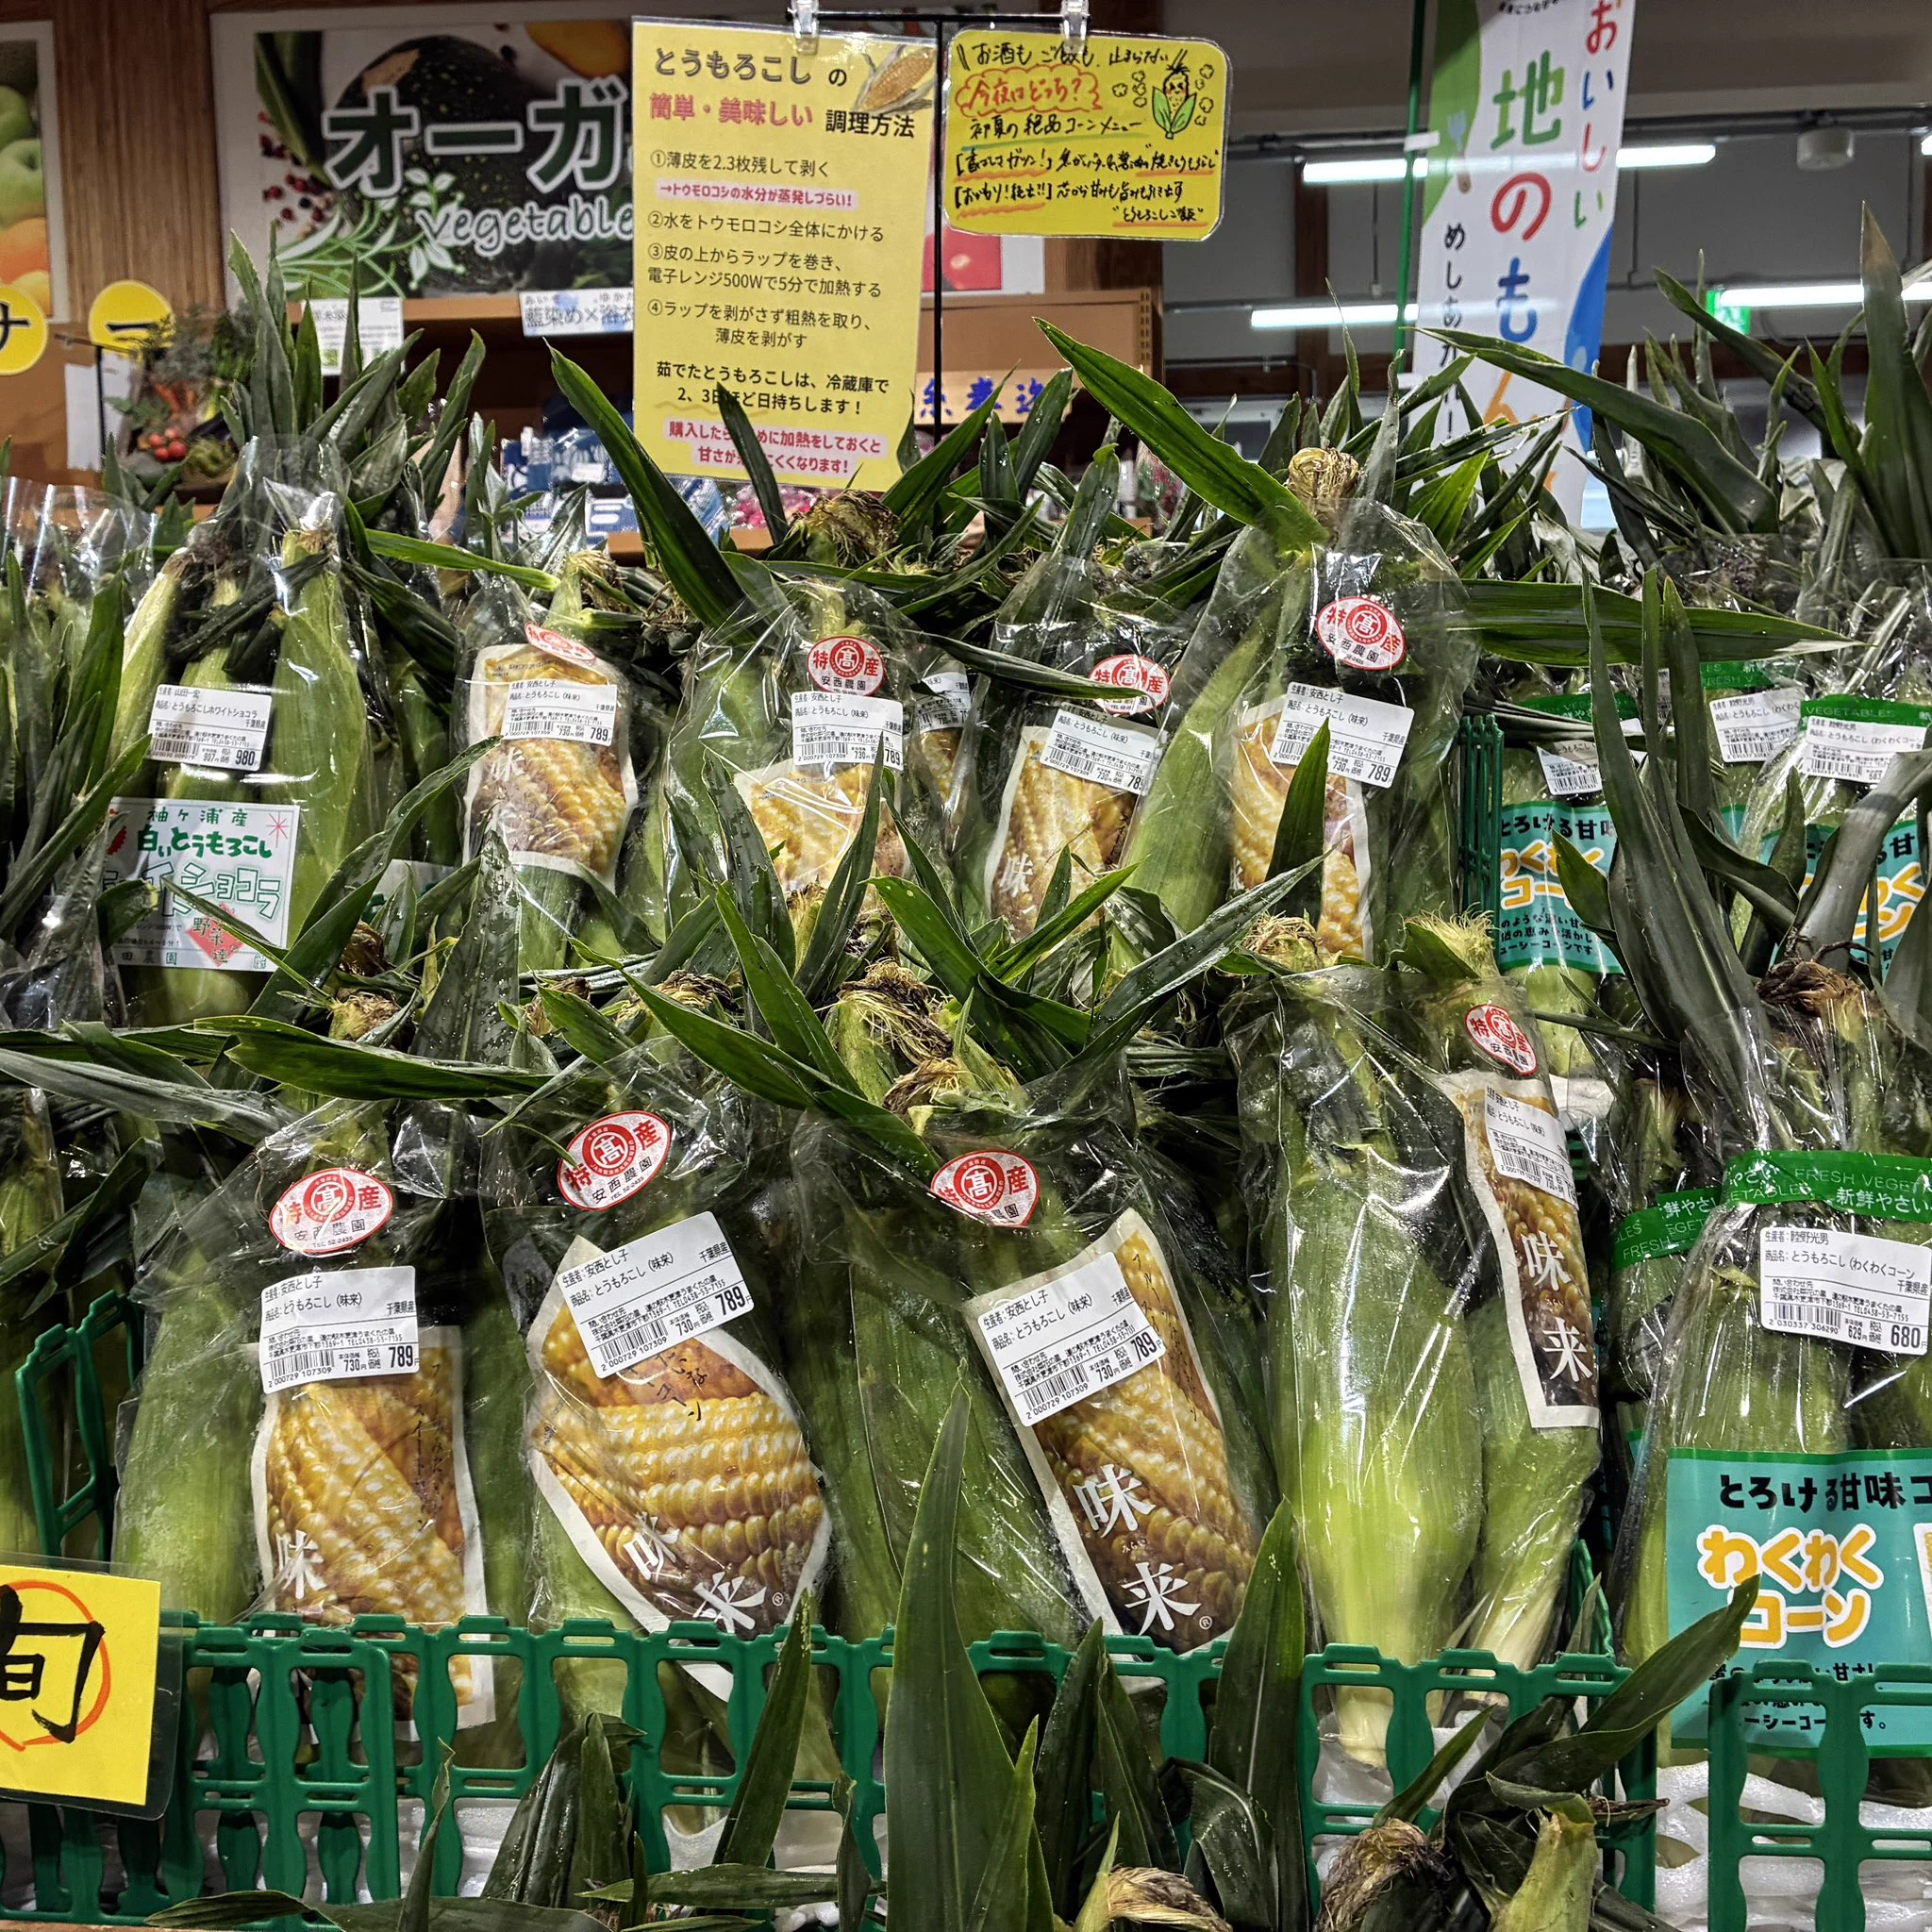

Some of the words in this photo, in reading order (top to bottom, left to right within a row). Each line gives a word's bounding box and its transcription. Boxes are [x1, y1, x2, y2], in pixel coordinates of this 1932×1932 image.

[656, 48, 811, 85] とうもろこし
[828, 68, 847, 87] の
[649, 92, 813, 126] 簡単・美味しい
[825, 109, 915, 139] 調理方法
[324, 77, 629, 198] オーガ
[648, 266, 881, 297] 電子レンジ500Wで5分で加熱する
[715, 327, 808, 348] 薄皮を剥がす
[138, 824, 273, 858] 白いとうもろこし
[632, 1119, 661, 1150] 産
[1007, 1165, 1030, 1196] 産
[1796, 1168, 1855, 1185] FRESH
[358, 1185, 382, 1211] 産
[1521, 1230, 1592, 1382] 味来
[608, 1351, 638, 1369] 000729
[640, 1337, 668, 1355] 107309
[274, 1374, 299, 1386] 000729
[302, 1367, 332, 1378] 107309
[1033, 1397, 1060, 1416] 000729
[1061, 1383, 1089, 1402] 107309
[1073, 1464, 1202, 1636] 味来
[1697, 1523, 1885, 1595] わくわく
[1728, 1589, 1872, 1650] コーン
